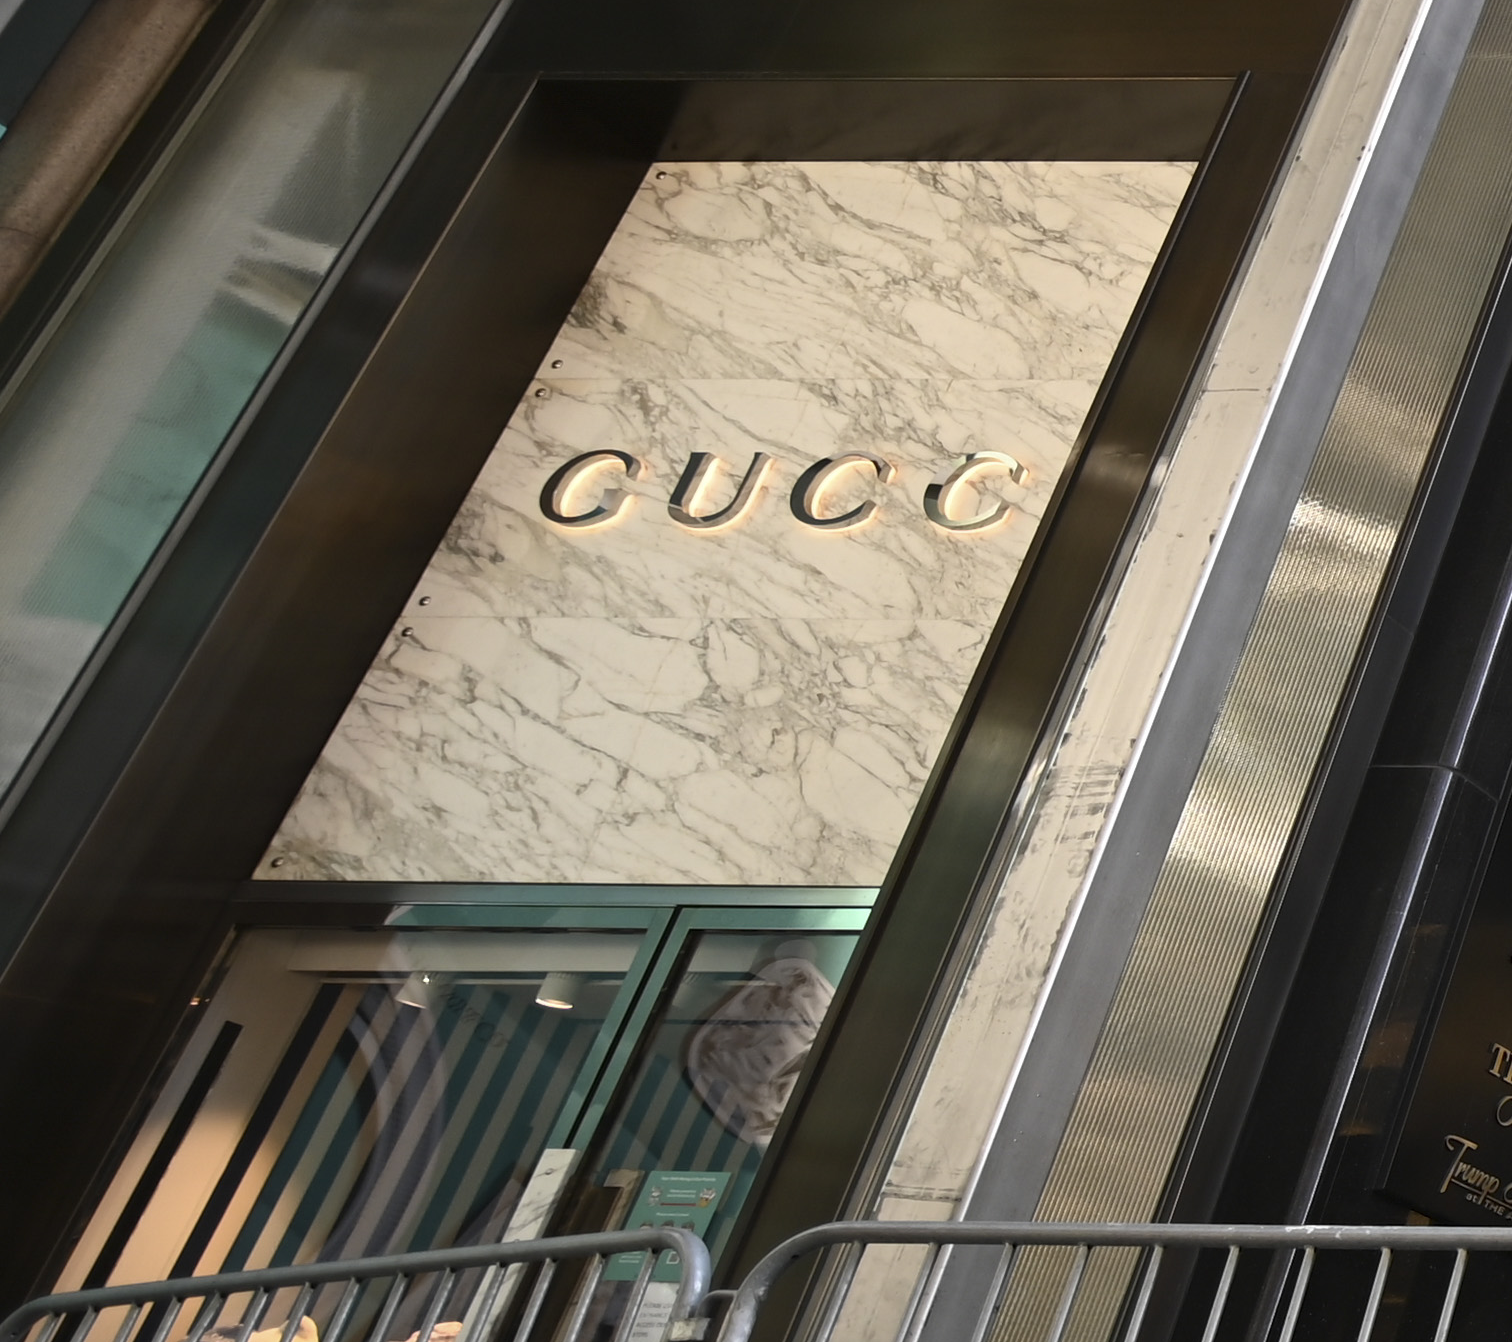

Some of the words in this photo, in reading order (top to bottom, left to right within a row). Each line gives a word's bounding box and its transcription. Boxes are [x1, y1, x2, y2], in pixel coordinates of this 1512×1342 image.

[539, 448, 1030, 533] GUCC
[1440, 1134, 1500, 1205] Trump
[1484, 1200, 1506, 1216] THE
